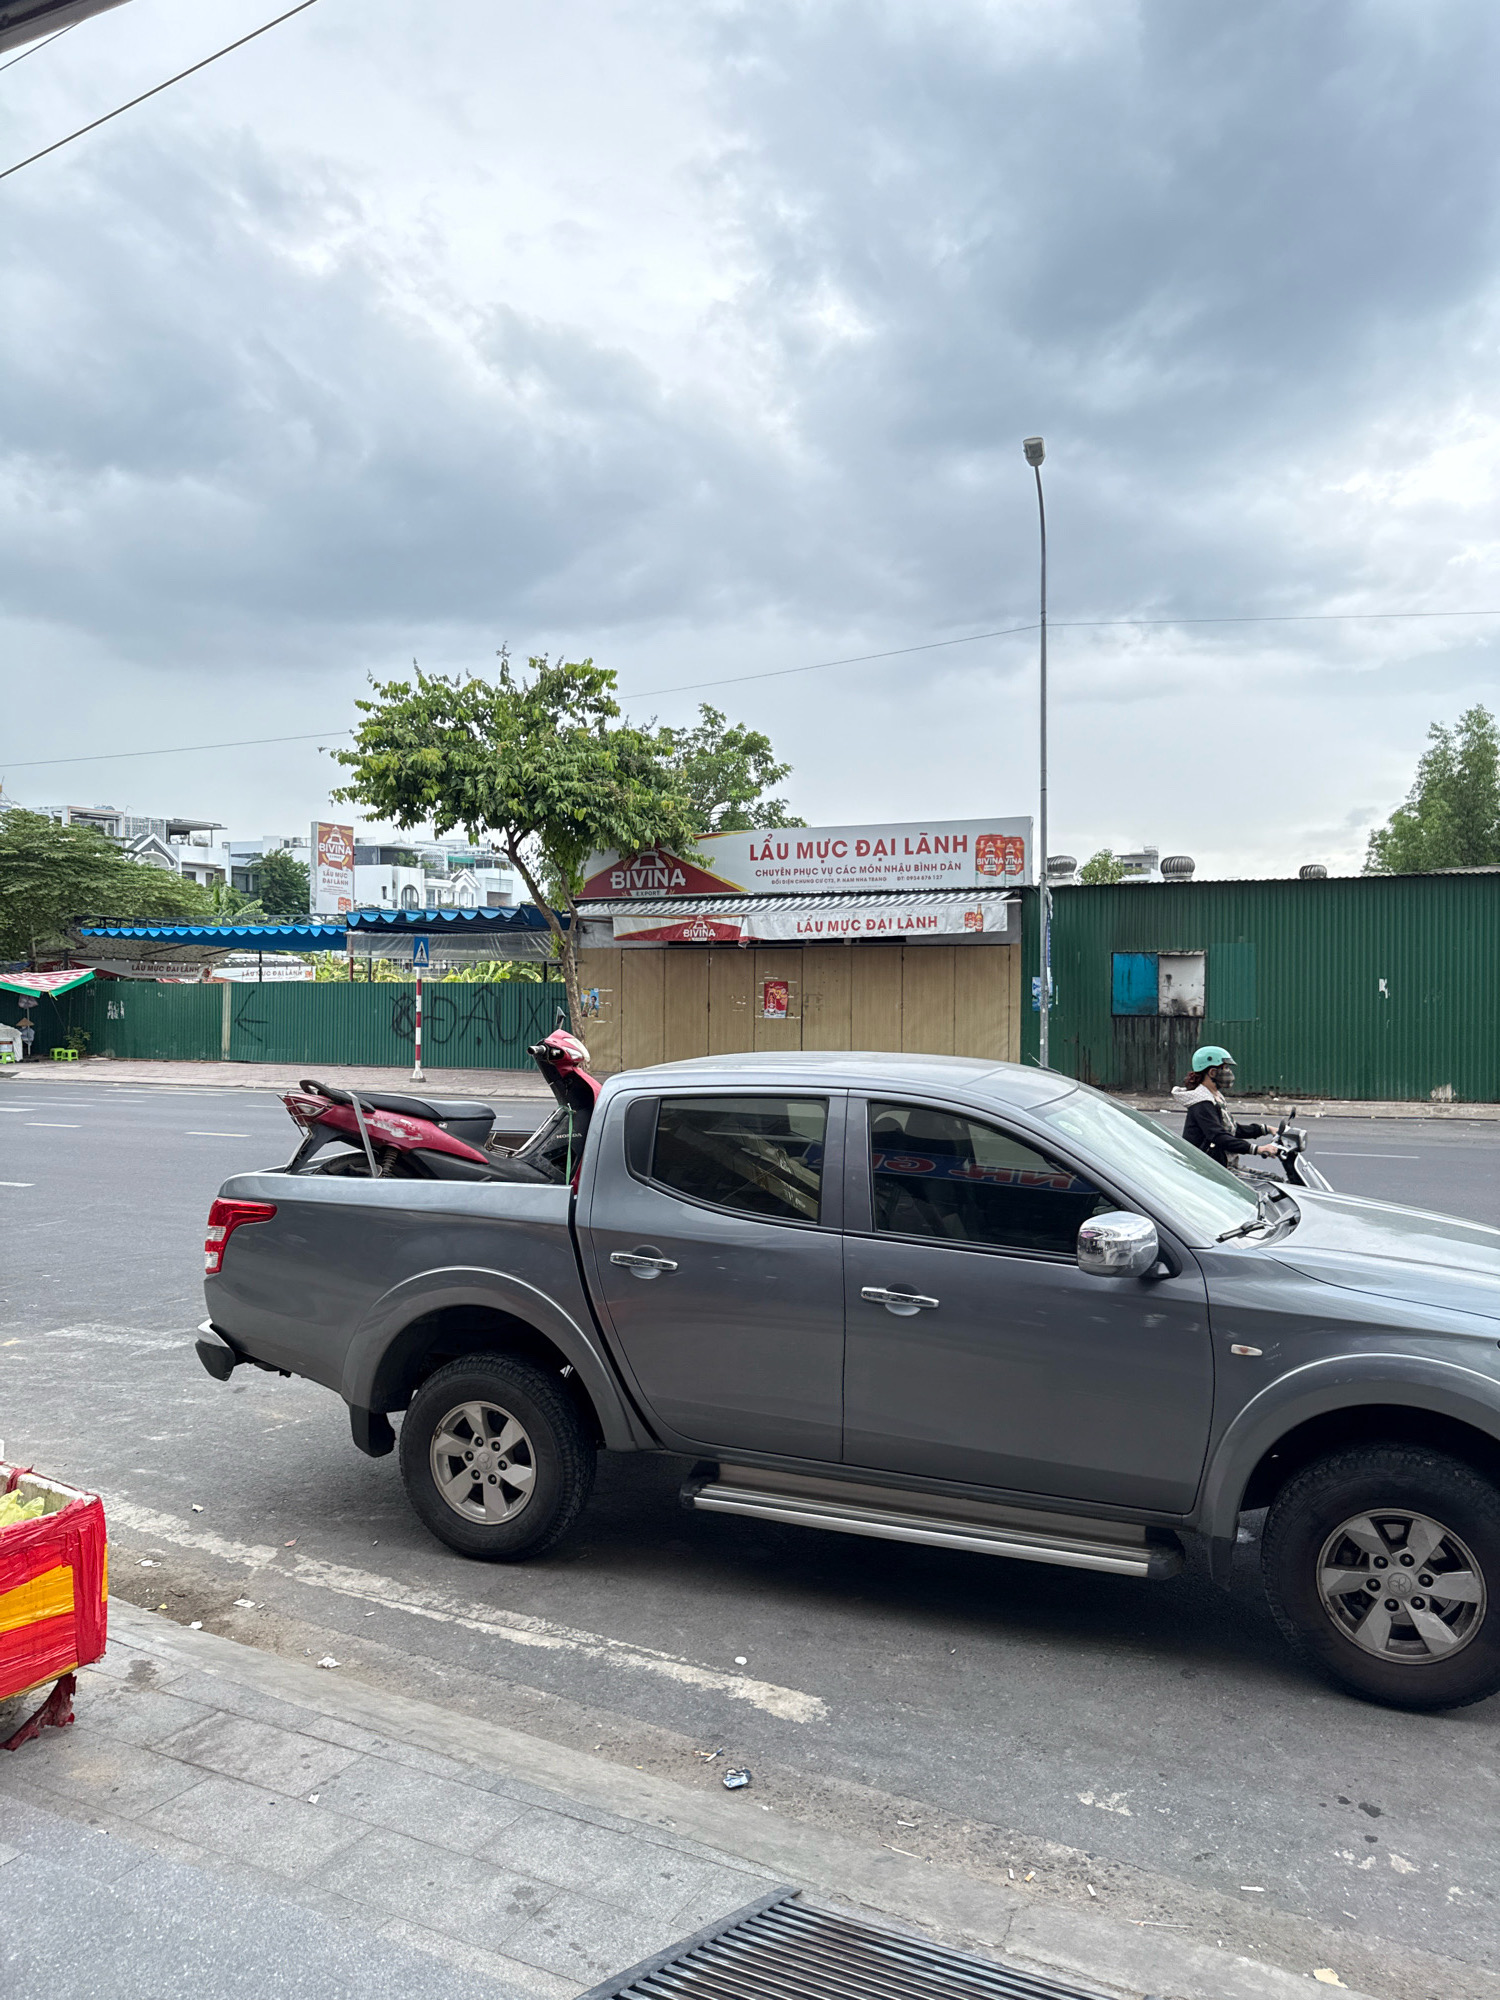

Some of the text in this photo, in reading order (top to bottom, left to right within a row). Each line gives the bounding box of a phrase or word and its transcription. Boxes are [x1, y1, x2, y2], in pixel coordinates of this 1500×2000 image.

[318, 842, 352, 856] BIVINA
[749, 832, 968, 864] LẨU MỰC ĐẠI LÃNH
[755, 859, 962, 878] CHUYÊN PHỤC VỤ CÁC MÓN NHẬU BÌNH DÂN
[977, 857, 1004, 865] BIVINA
[610, 868, 686, 889] BIVINA
[683, 928, 716, 938] BIVINA
[797, 914, 938, 935] LẨU MỰC ĐẠI LÃNH
